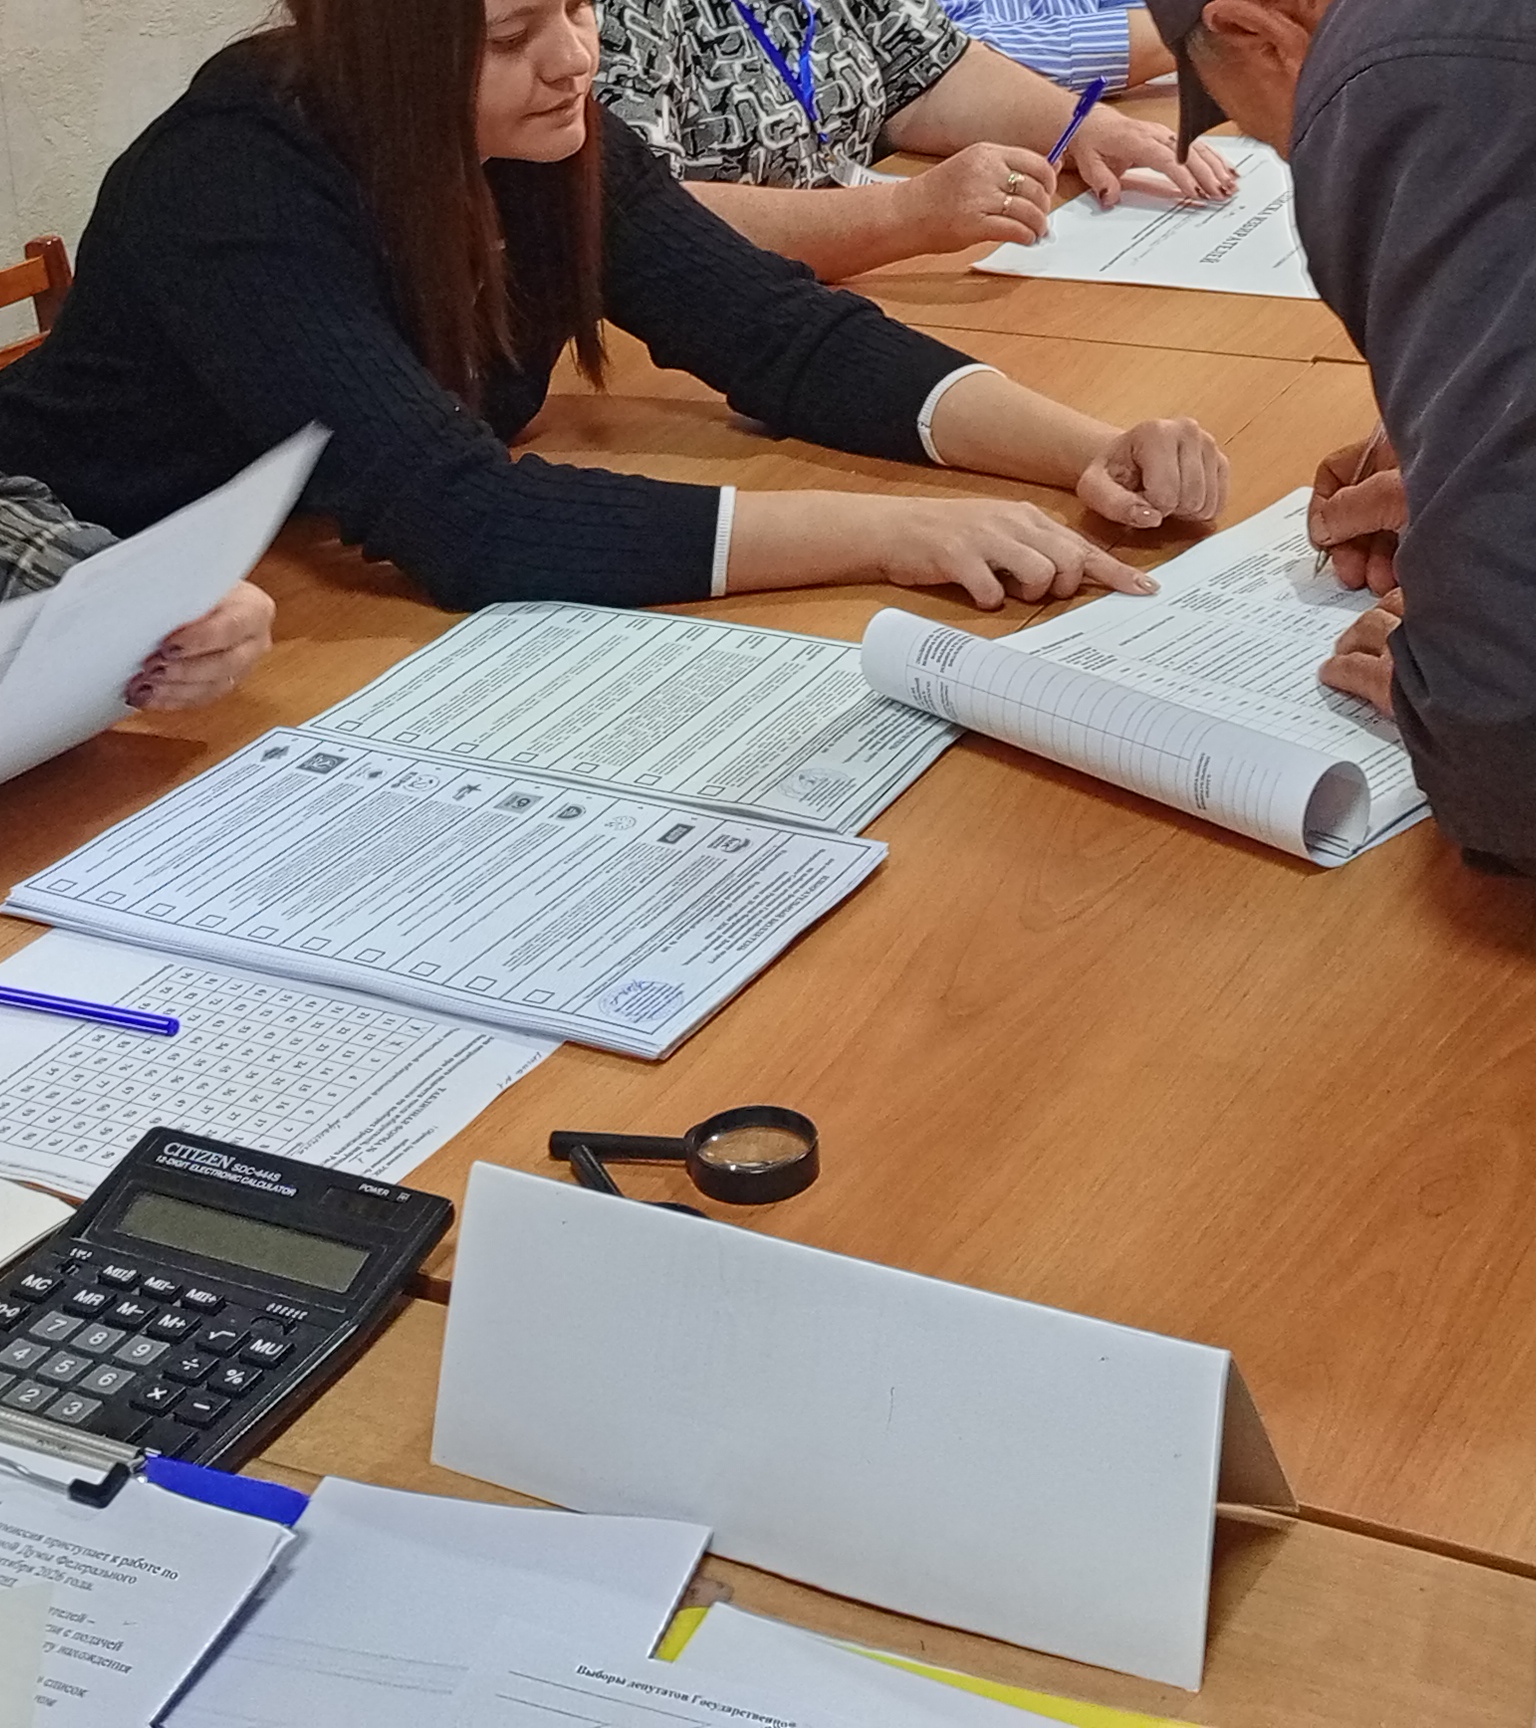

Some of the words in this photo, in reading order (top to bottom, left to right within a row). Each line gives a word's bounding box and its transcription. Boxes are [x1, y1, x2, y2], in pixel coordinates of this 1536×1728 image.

[330, 1006, 345, 1014] 31
[356, 1012, 371, 1020] 21
[382, 1018, 396, 1026] 11
[336, 1026, 351, 1035] 22
[362, 1033, 377, 1041] 12
[315, 1043, 330, 1052] 23
[341, 1050, 356, 1058] 13
[293, 1060, 308, 1069] 24
[319, 1067, 334, 1076] 14
[271, 1077, 286, 1086] 25
[298, 1083, 312, 1092] 15
[249, 1094, 264, 1103] 26
[275, 1101, 290, 1110] 16
[226, 1111, 241, 1121] 27
[254, 1118, 267, 1128] 17
[164, 1142, 236, 1169] CITIZEN
[156, 1155, 190, 1168] 12-DIGIT
[188, 1164, 242, 1182] ELECTRONIC
[240, 1176, 297, 1197] CALCULATOR
[358, 1182, 390, 1197] POWER
[21, 1274, 52, 1290] MC
[73, 1289, 105, 1307] MR
[47, 1319, 67, 1332] 7
[85, 1331, 108, 1345] 8
[132, 1343, 151, 1357] 9
[250, 1338, 283, 1355] MU
[12, 1347, 31, 1360] 4
[54, 1360, 74, 1372] 5
[97, 1372, 117, 1386] 6
[18, 1388, 40, 1402] 2
[63, 1401, 83, 1415] 3
[17, 1543, 55, 1562] Думы
[56, 1555, 138, 1585] Федерального
[43, 1537, 112, 1561] приступает
[117, 1556, 161, 1574] работе
[160, 1569, 179, 1581] по
[72, 1632, 124, 1652] подачей
[57, 1645, 133, 1674] нахождения
[576, 1665, 626, 1684] Выборы
[627, 1679, 689, 1701] депутатов
[43, 1679, 89, 1698] список
